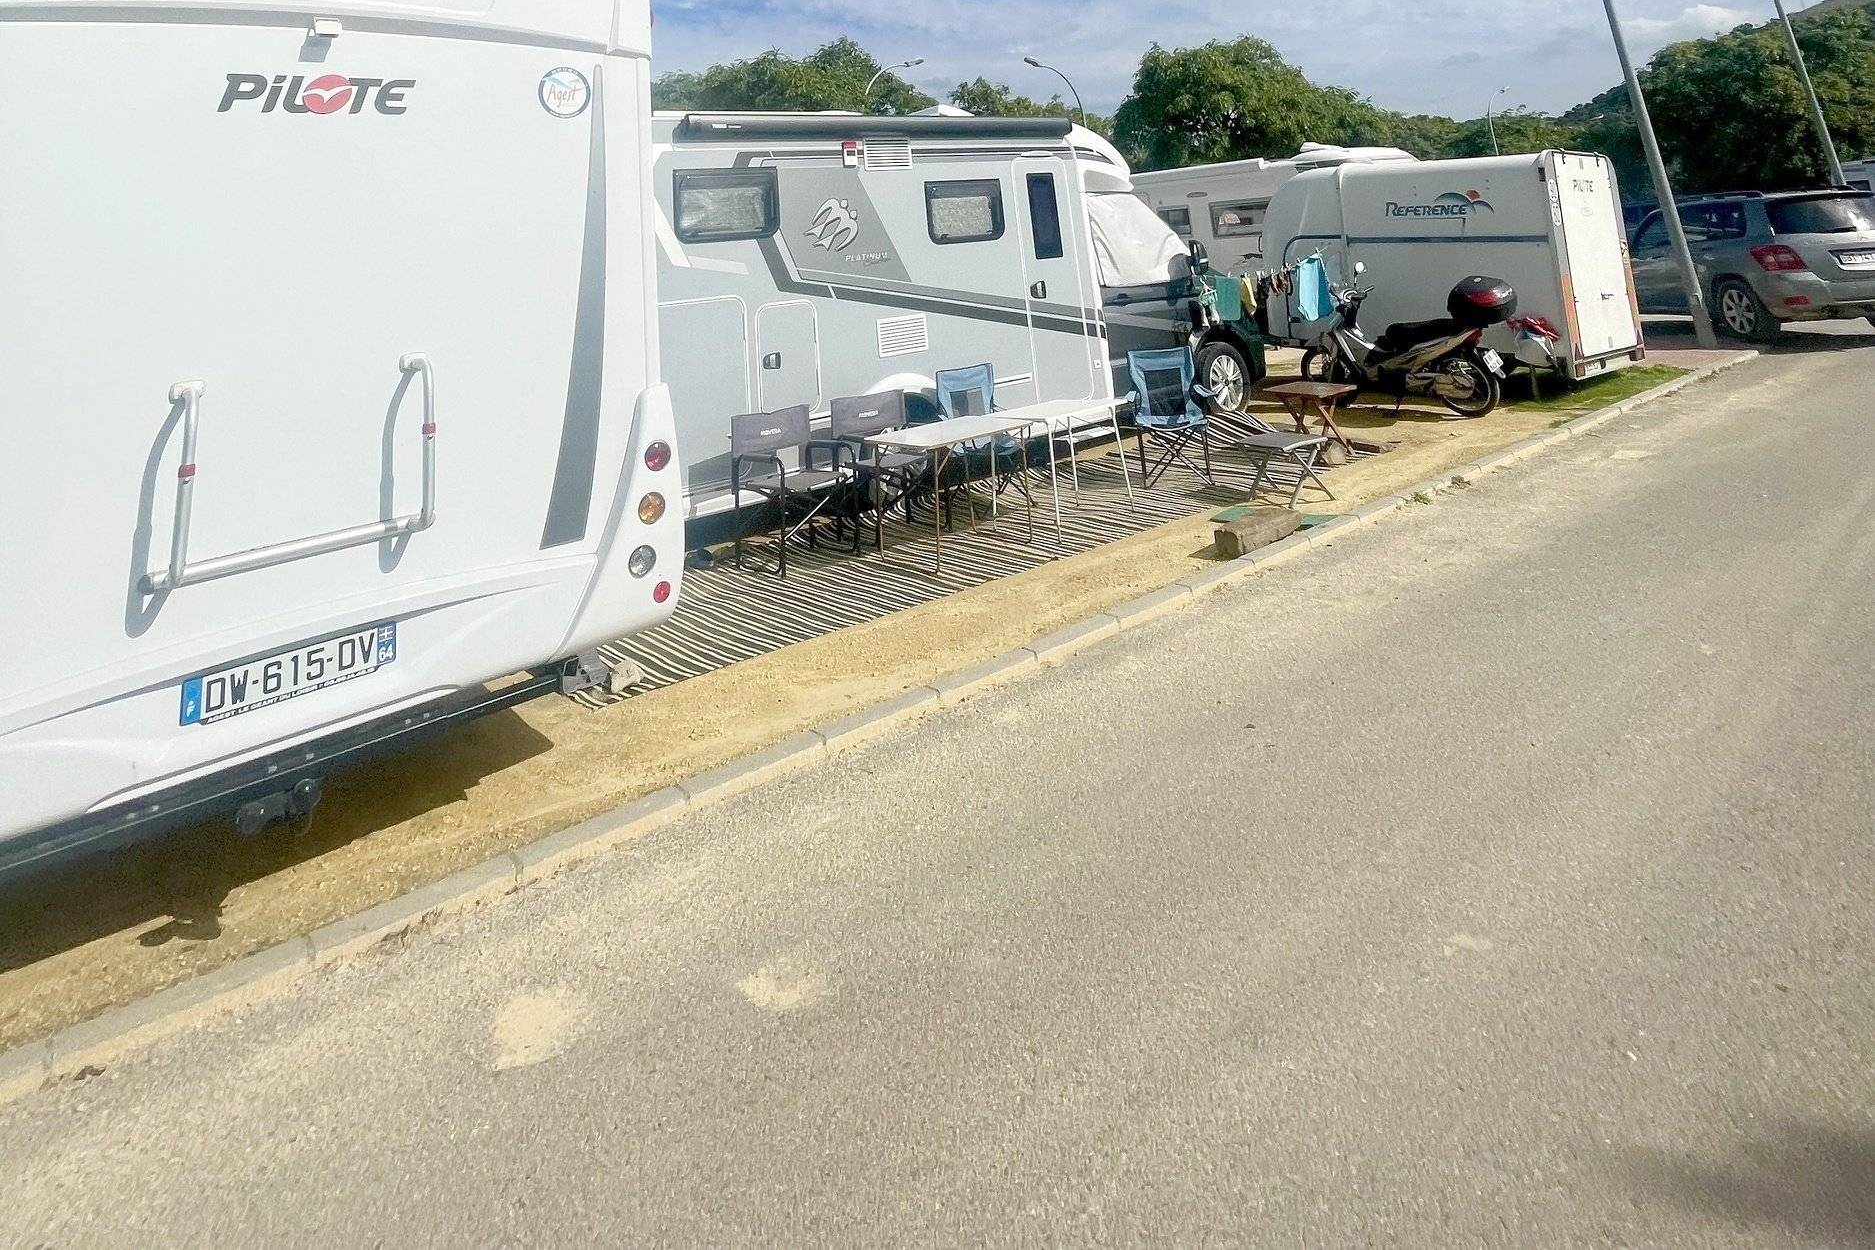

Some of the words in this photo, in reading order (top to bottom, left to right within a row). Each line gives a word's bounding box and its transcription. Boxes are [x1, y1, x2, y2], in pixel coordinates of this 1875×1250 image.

[845, 251, 888, 262] PLATINUM
[379, 644, 393, 661] 64
[205, 632, 375, 713] DW-615-DV
